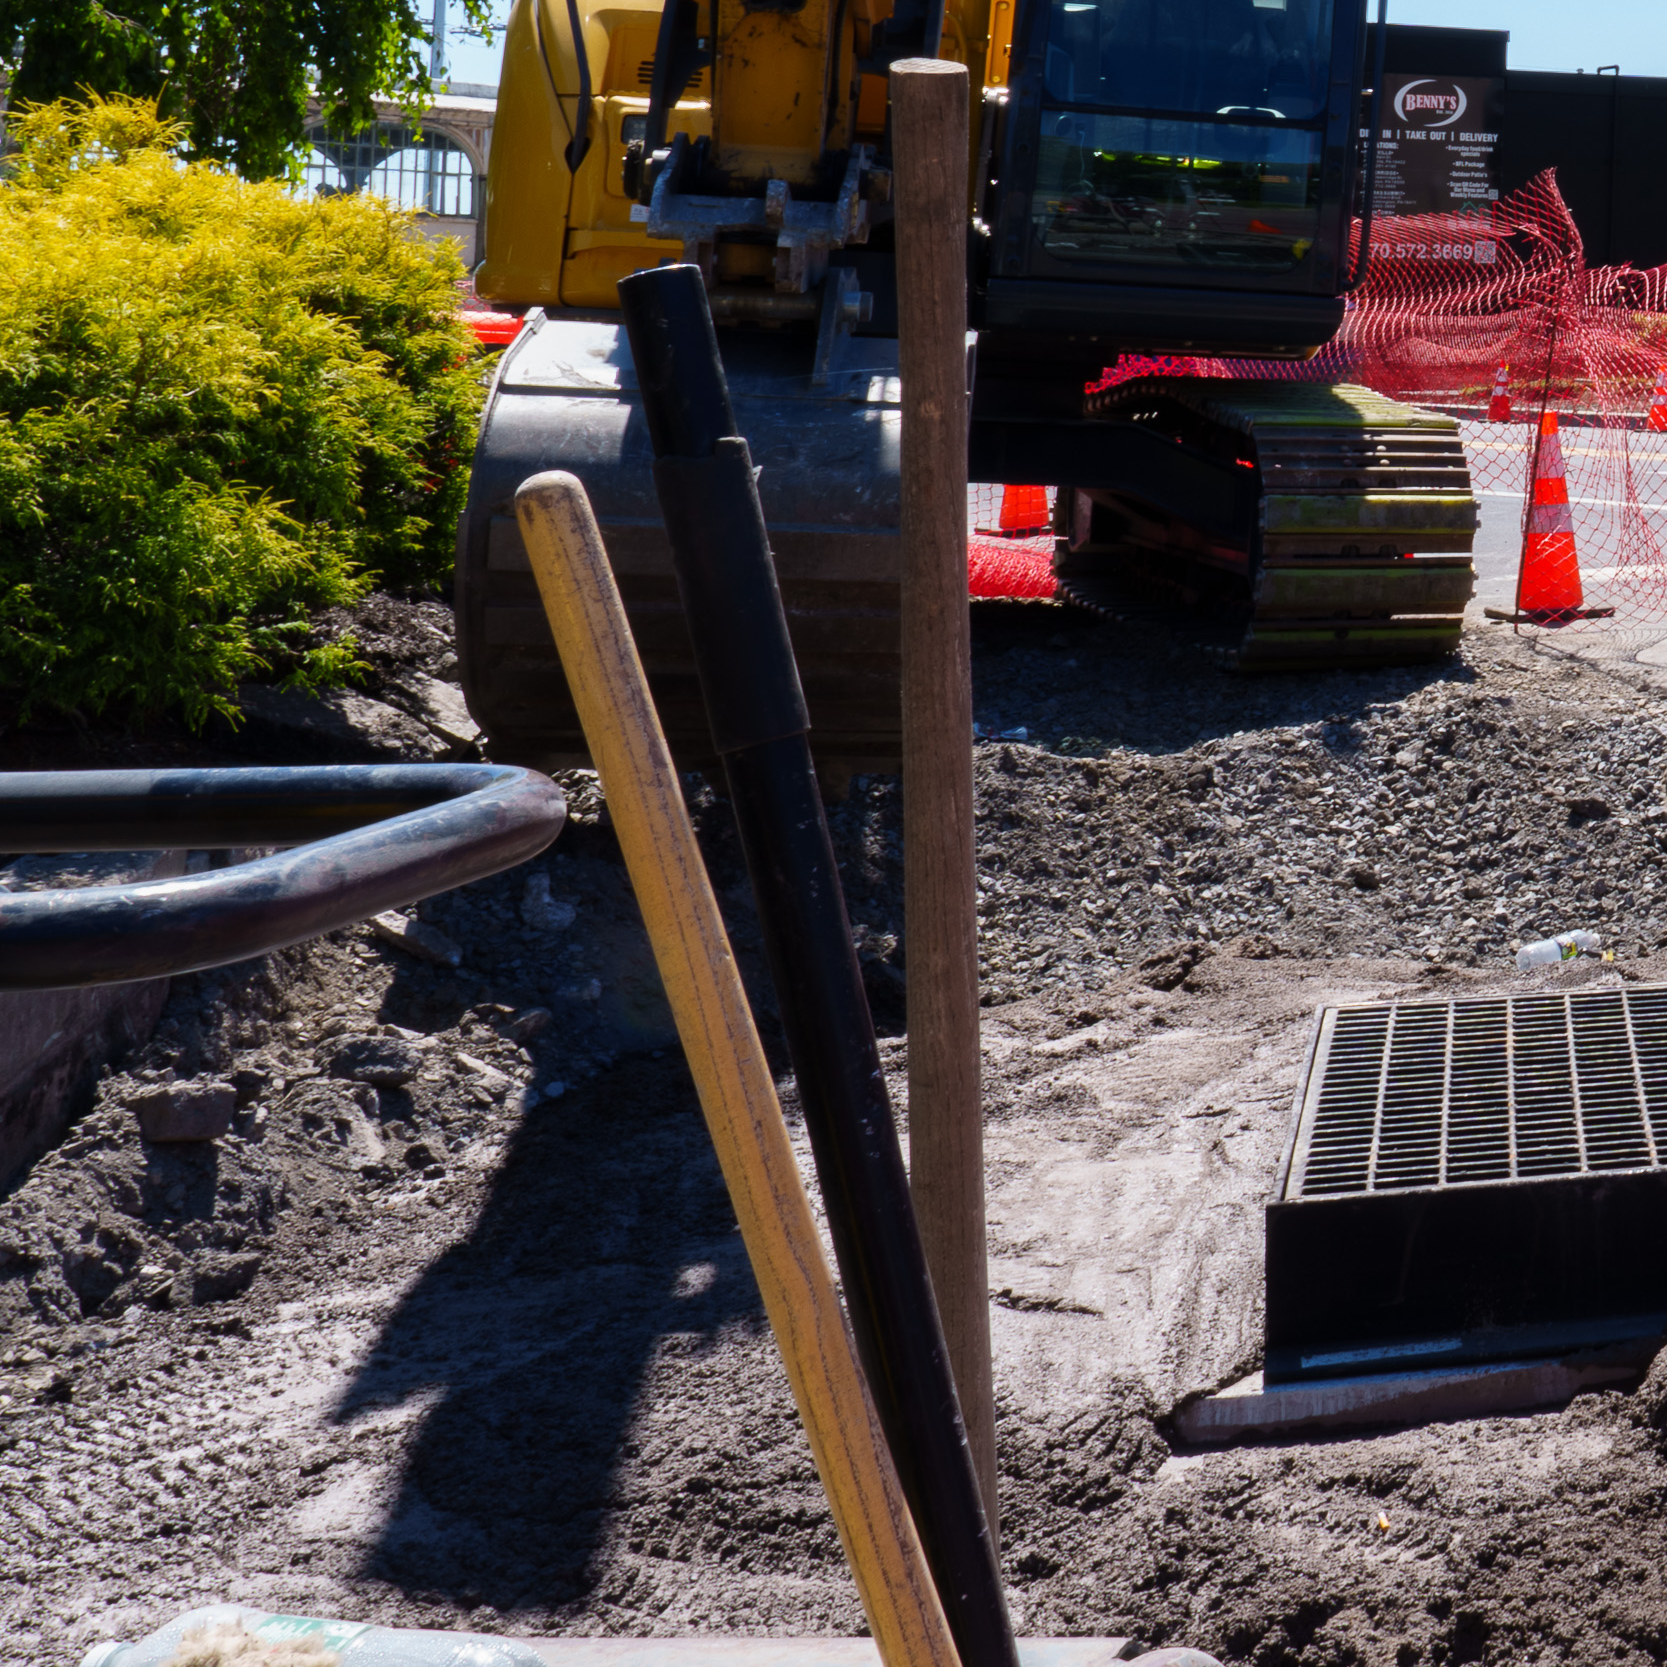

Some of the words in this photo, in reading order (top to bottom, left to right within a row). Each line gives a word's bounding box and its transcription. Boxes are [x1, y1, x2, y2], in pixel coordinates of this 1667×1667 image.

[1405, 94, 1457, 111] BENNY'S
[1382, 129, 1392, 138] IN
[1405, 130, 1427, 140] TAKE
[1429, 131, 1447, 141] OUT
[1459, 132, 1498, 143] DELIVERY
[1370, 243, 1473, 260] 70.572.3669
